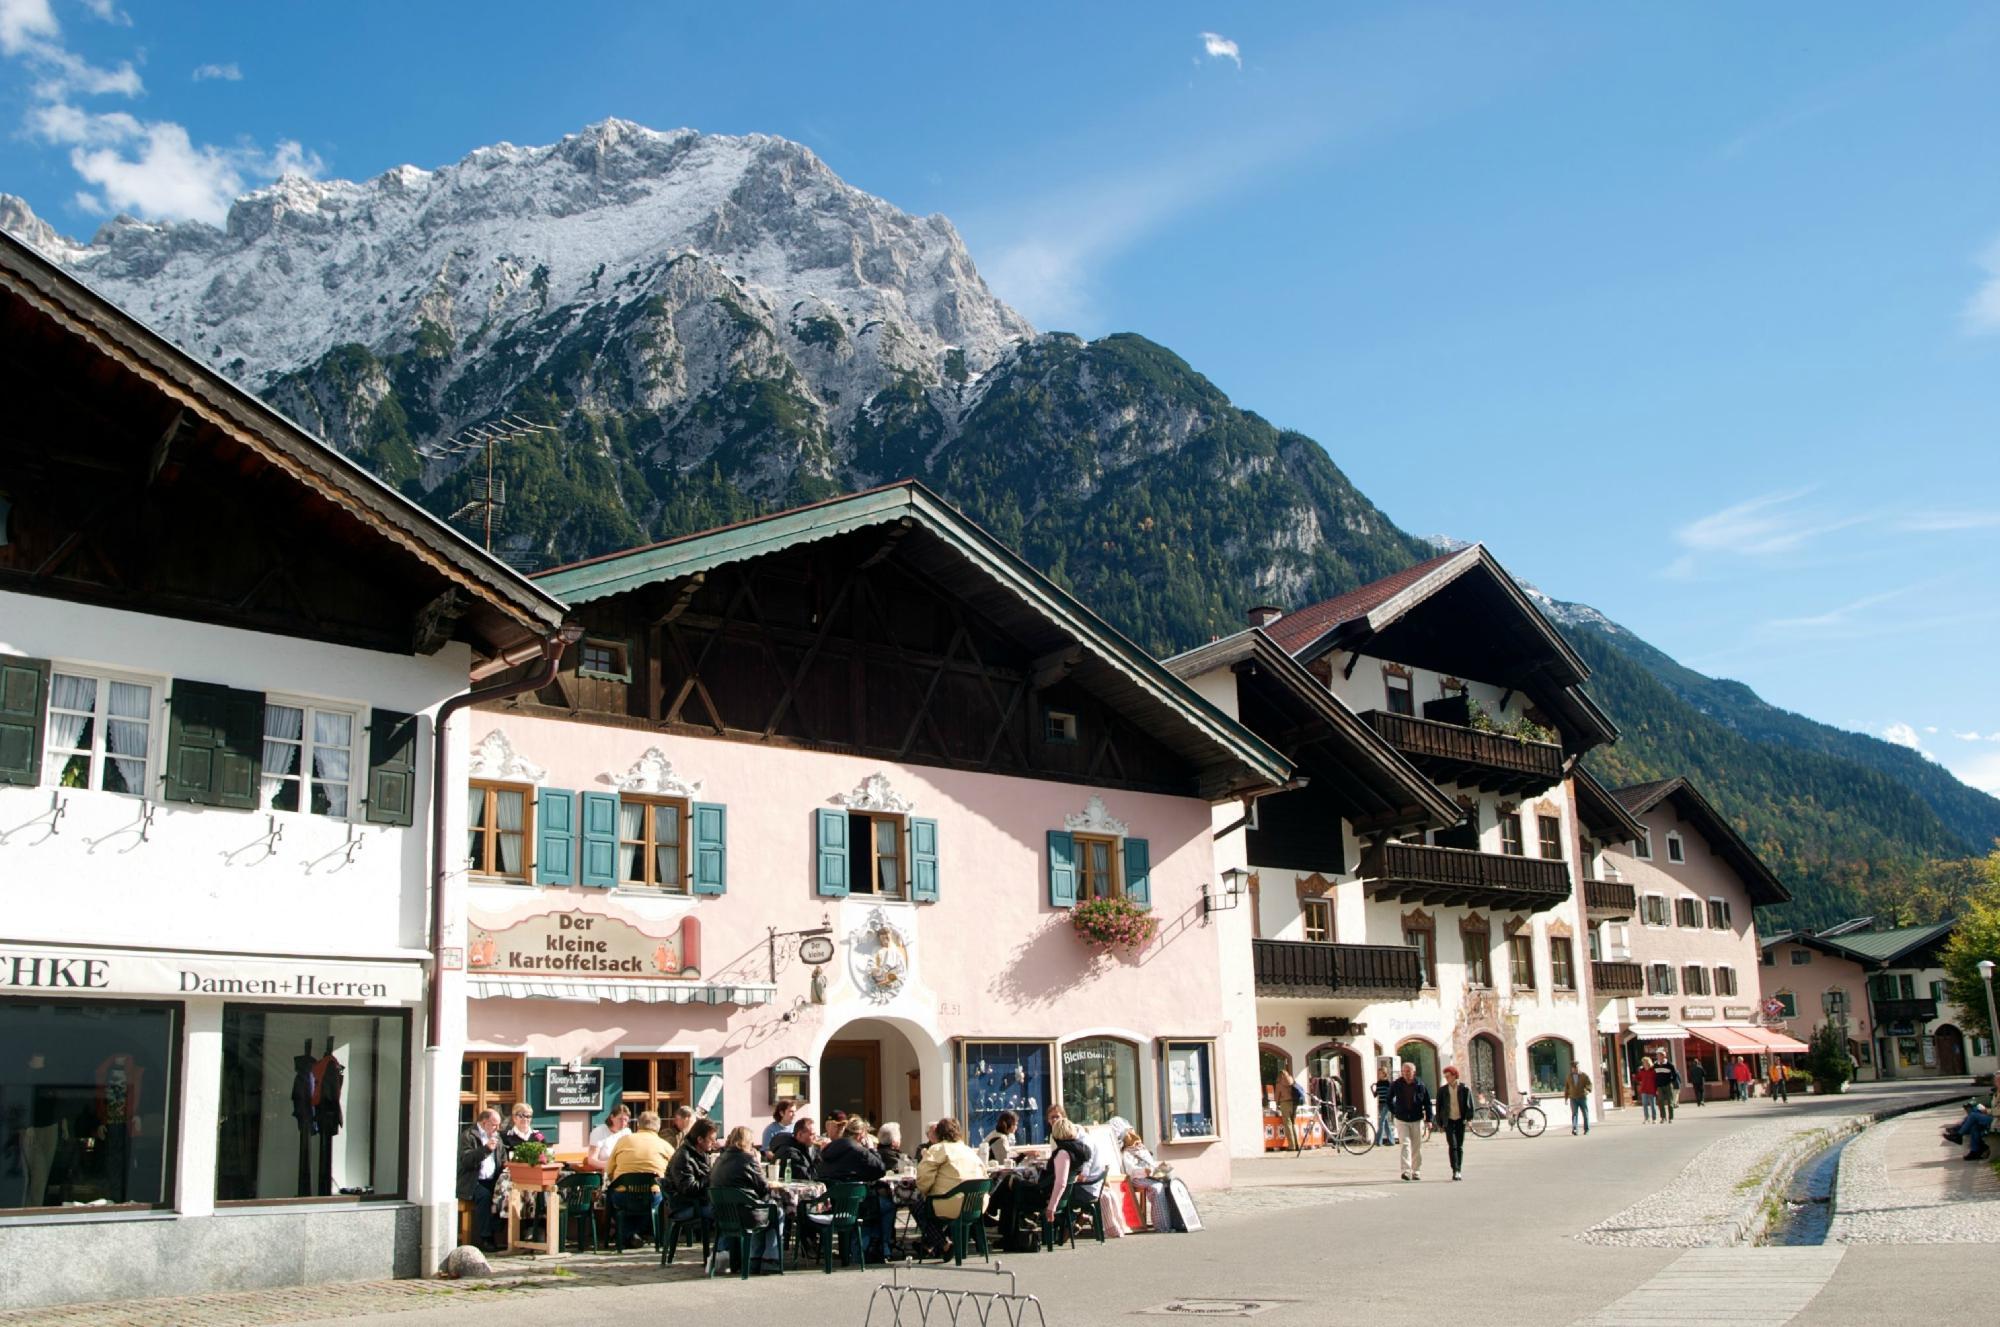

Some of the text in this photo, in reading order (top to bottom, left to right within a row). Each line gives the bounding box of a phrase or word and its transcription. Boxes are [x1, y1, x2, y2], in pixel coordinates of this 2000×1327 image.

[559, 914, 594, 930] Der
[546, 935, 607, 953] kleine
[509, 951, 642, 972] Kartoffelsack
[0, 956, 387, 998] HKE Damen+Herren
